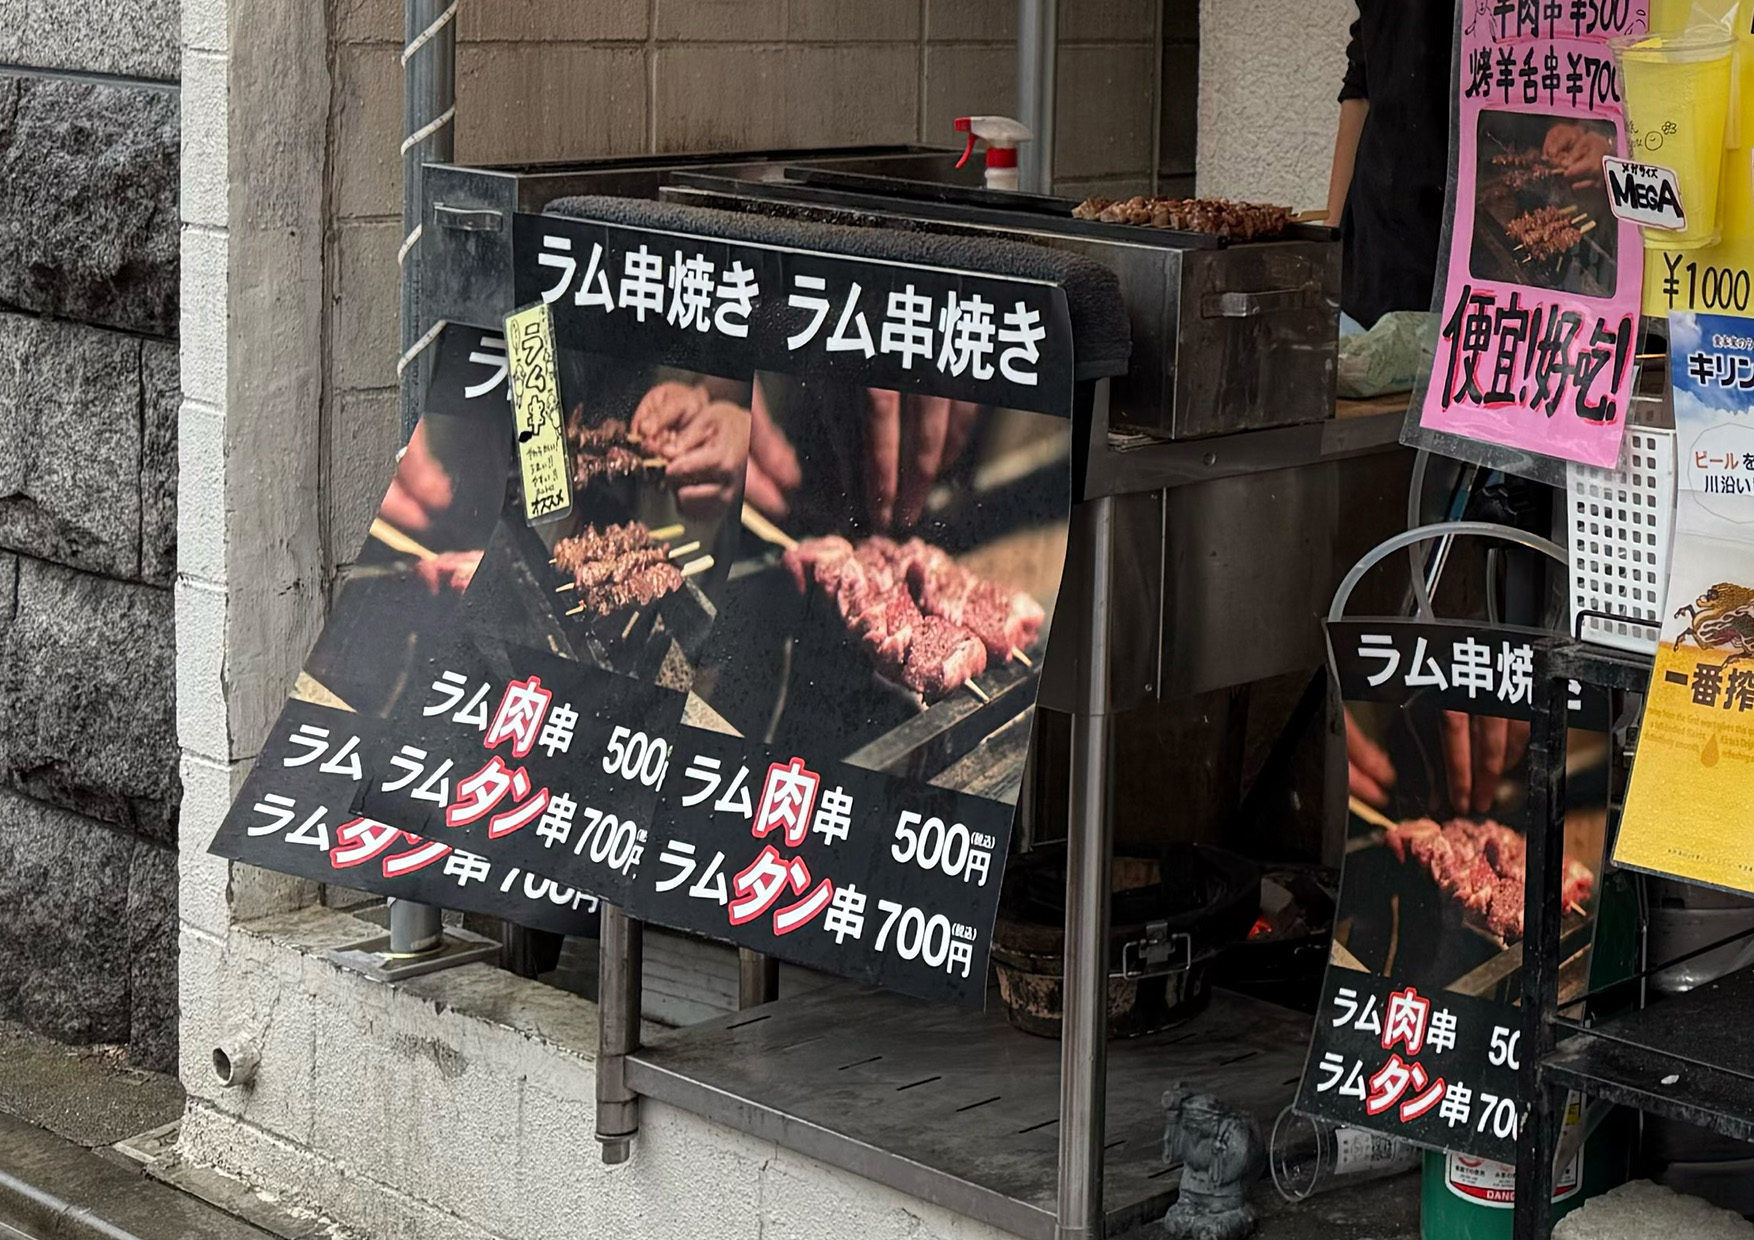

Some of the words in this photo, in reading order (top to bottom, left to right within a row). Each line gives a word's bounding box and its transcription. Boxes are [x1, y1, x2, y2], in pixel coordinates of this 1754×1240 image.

[1609, 170, 1684, 218] MEGA
[538, 235, 761, 338] ラム串焼き
[1663, 252, 1751, 312] ¥1000
[786, 275, 1048, 387] ラム串焼き
[423, 670, 579, 758] ラム肉串
[381, 745, 577, 849] ラムタン串
[682, 755, 853, 847] ラム肉串
[890, 811, 992, 886] 500円
[655, 840, 866, 944] ラムタン串
[874, 900, 974, 978] 700円
[1332, 987, 1457, 1056] ラム肉串
[1317, 1051, 1470, 1128] ラムタン串
